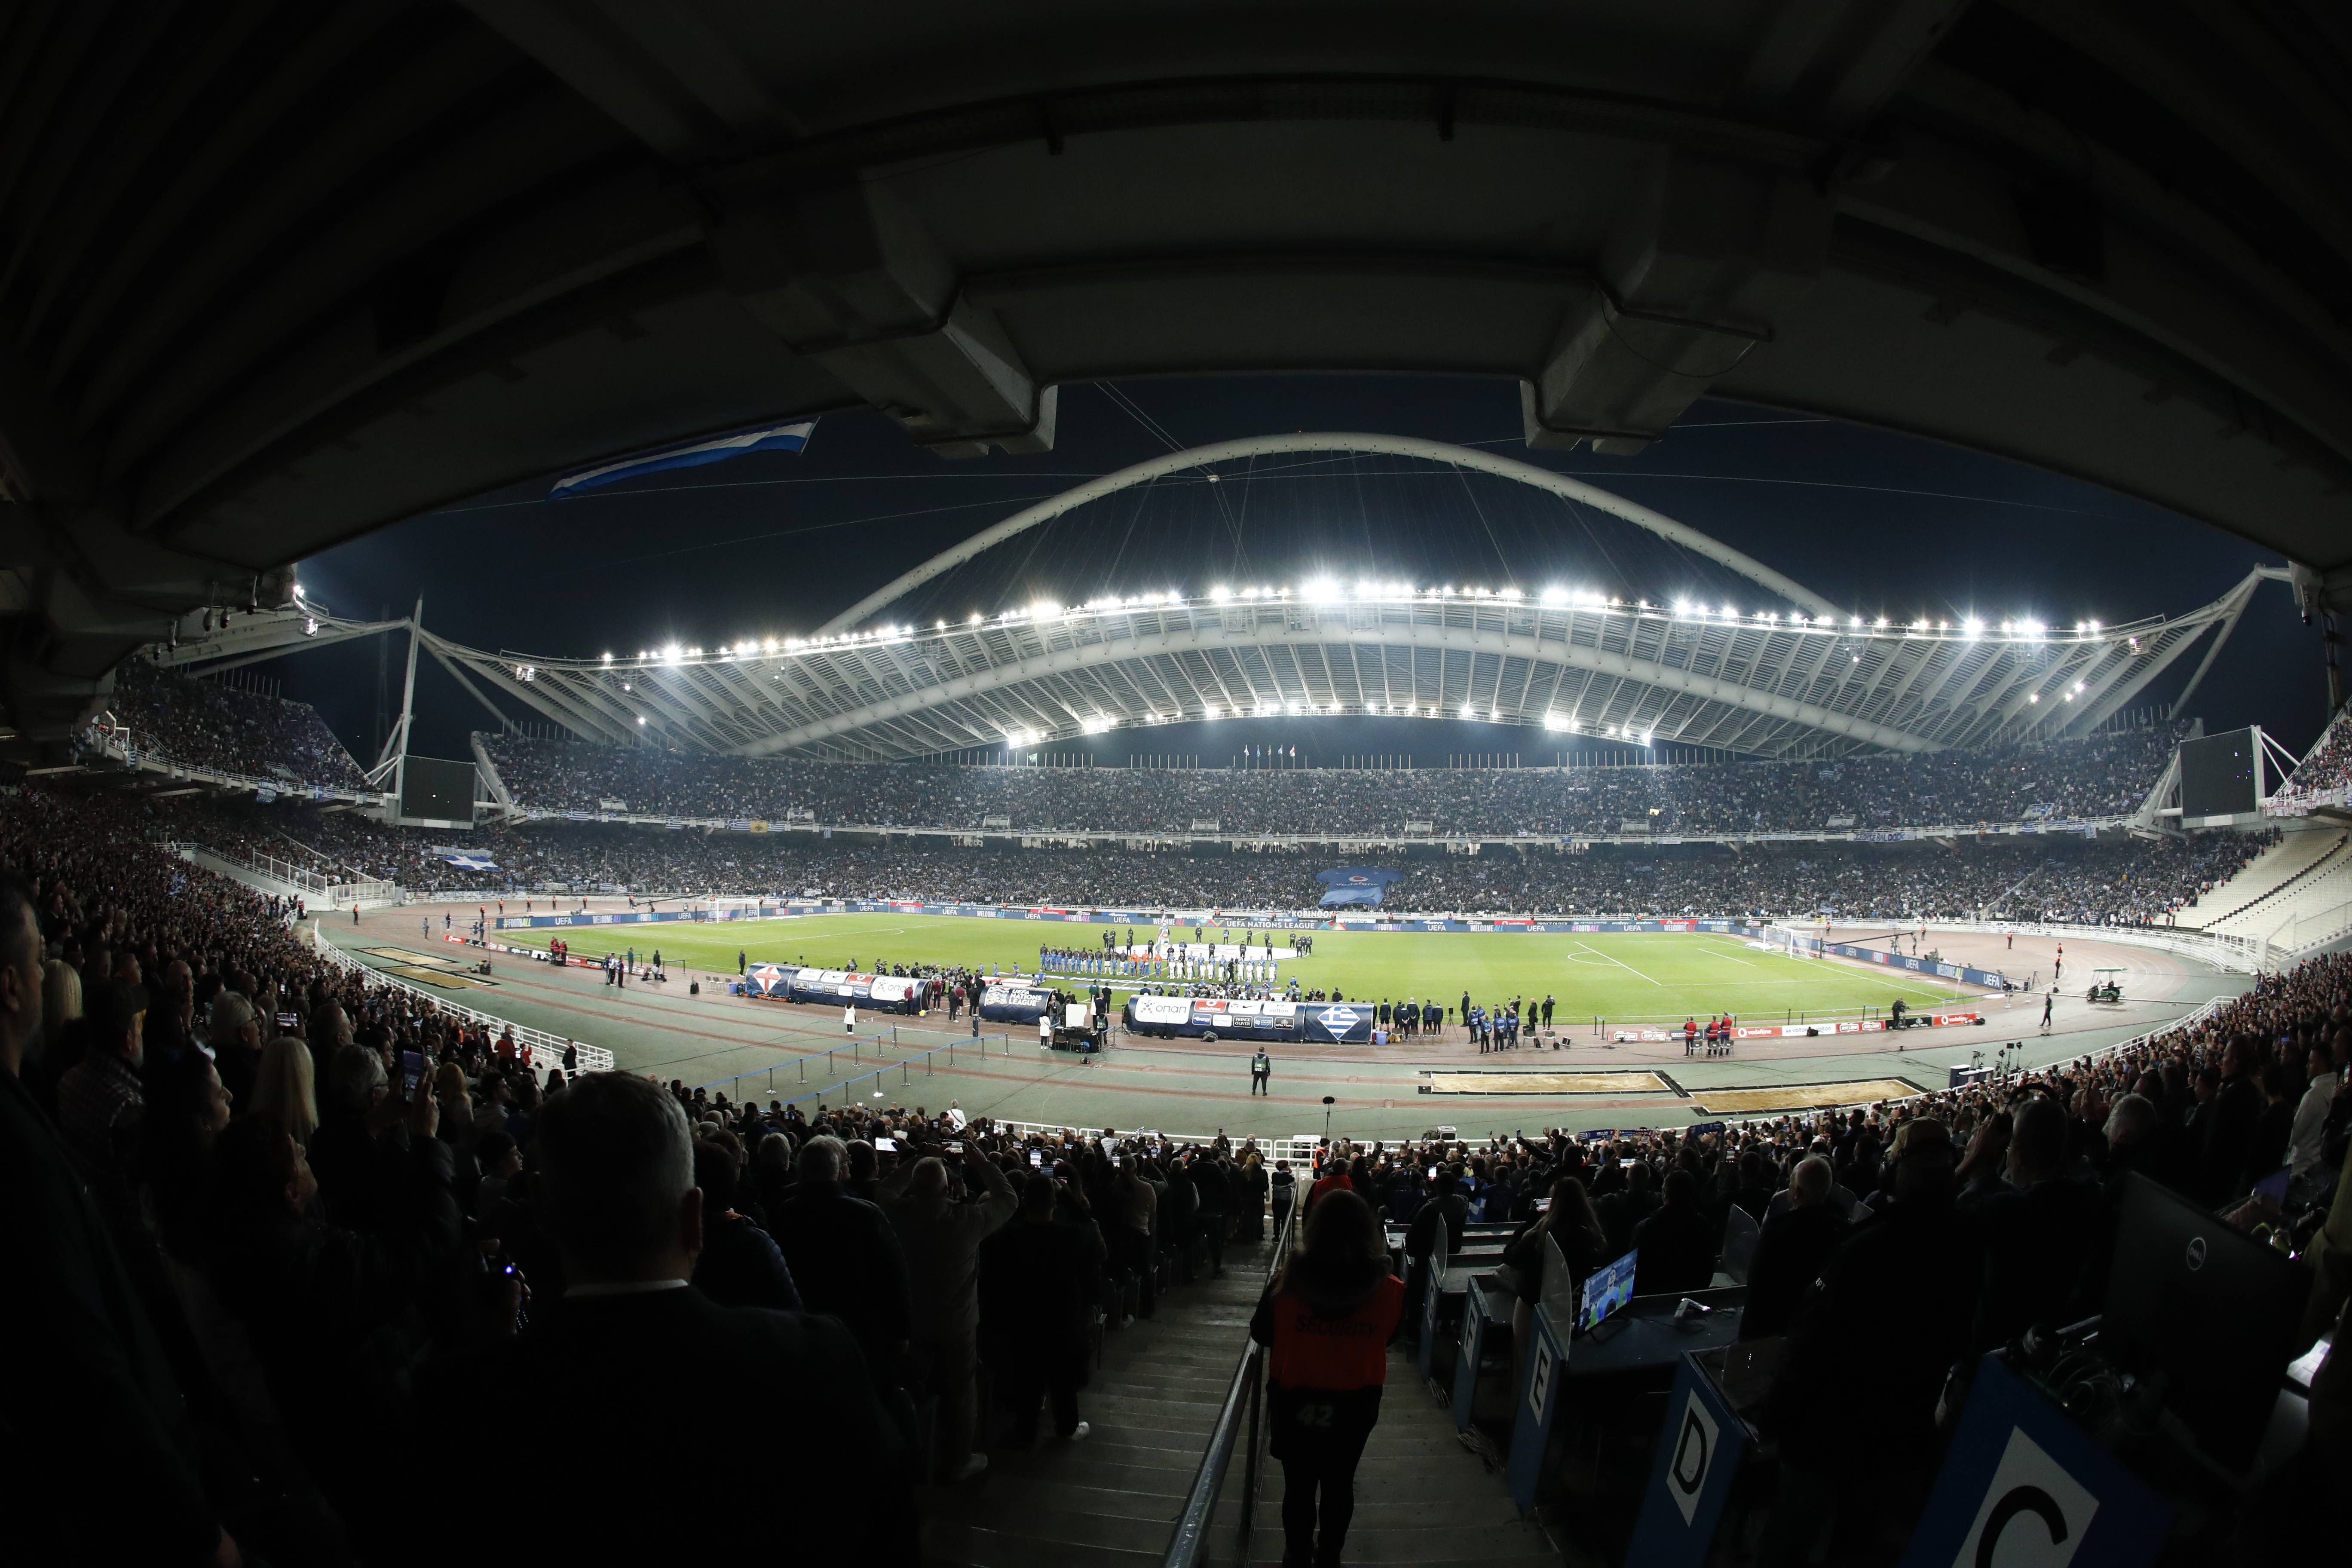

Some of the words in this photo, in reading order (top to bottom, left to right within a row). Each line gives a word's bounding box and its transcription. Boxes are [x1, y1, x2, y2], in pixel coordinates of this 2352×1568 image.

[504, 918, 531, 928] #FOOTBALL
[555, 917, 572, 925] UEFA
[593, 915, 612, 924] WELCOME
[612, 914, 621, 923] ALL
[1846, 947, 1857, 957] UEFA
[1905, 959, 1919, 970] UEFA
[1983, 974, 2000, 987] UEFA
[1008, 998, 1037, 1006] LEAGUE
[1010, 993, 1042, 1001] NATIONS
[2189, 1246, 2202, 1262] DELL
[1296, 1314, 1378, 1339] SECURITY
[1466, 1309, 1476, 1348] F
[1533, 1347, 1548, 1411] E
[1295, 1403, 1334, 1427] 42
[1673, 1406, 1707, 1495] D
[1975, 1485, 2068, 1568] C
